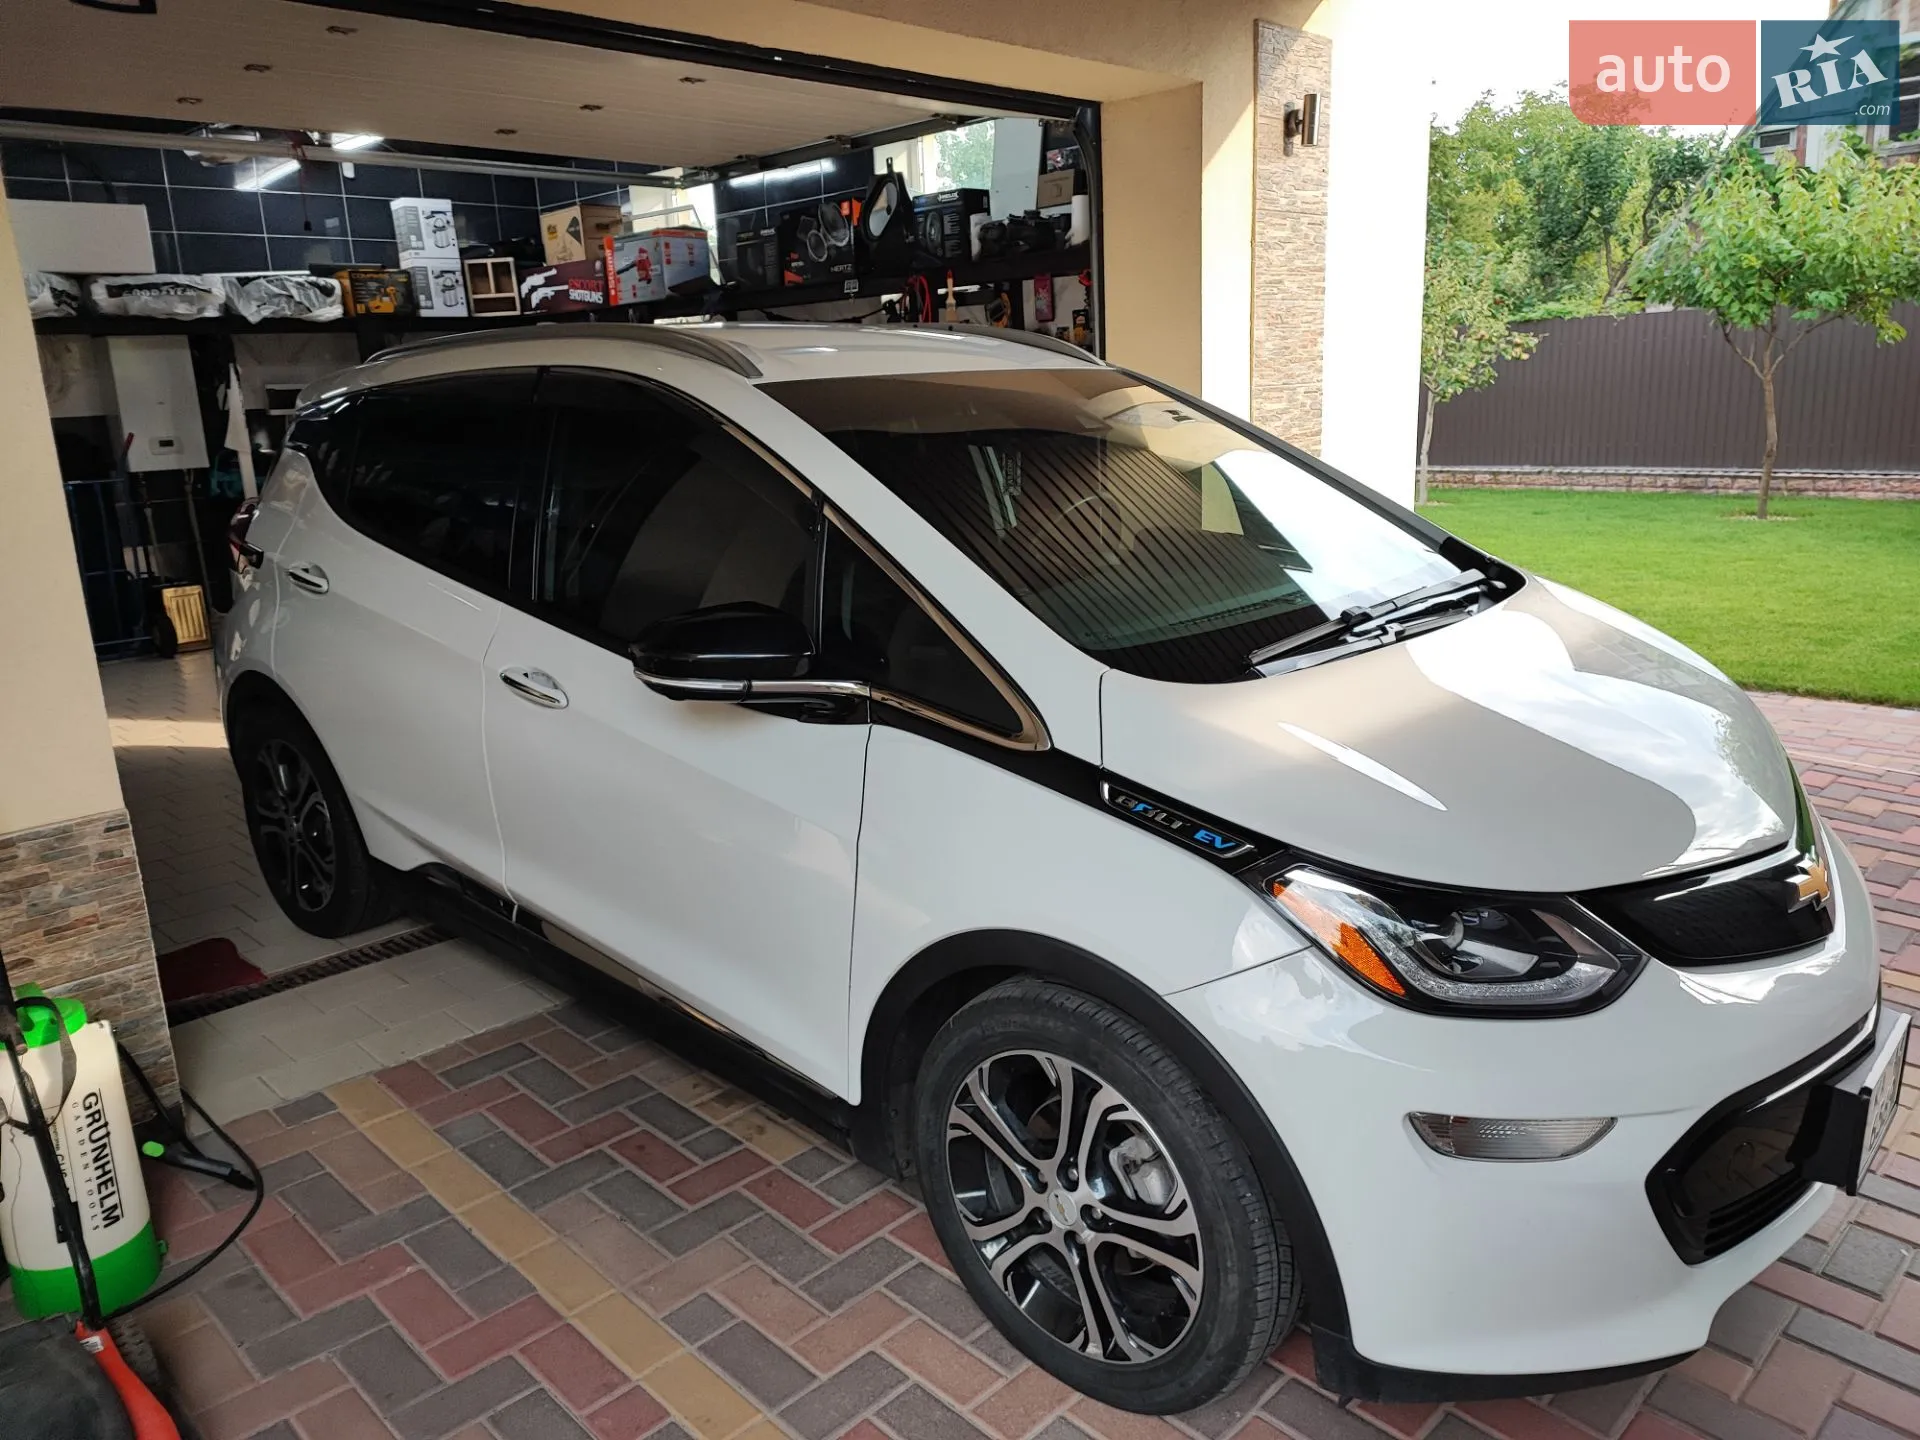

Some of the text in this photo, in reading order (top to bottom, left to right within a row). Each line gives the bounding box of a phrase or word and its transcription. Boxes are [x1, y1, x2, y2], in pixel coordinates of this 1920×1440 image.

[568, 289, 604, 304] SHOTGUNS
[1114, 795, 1237, 849] BOLT EV
[71, 1101, 100, 1231] GARDEN TOOLS
[82, 1091, 121, 1229] GRÜNHELM
